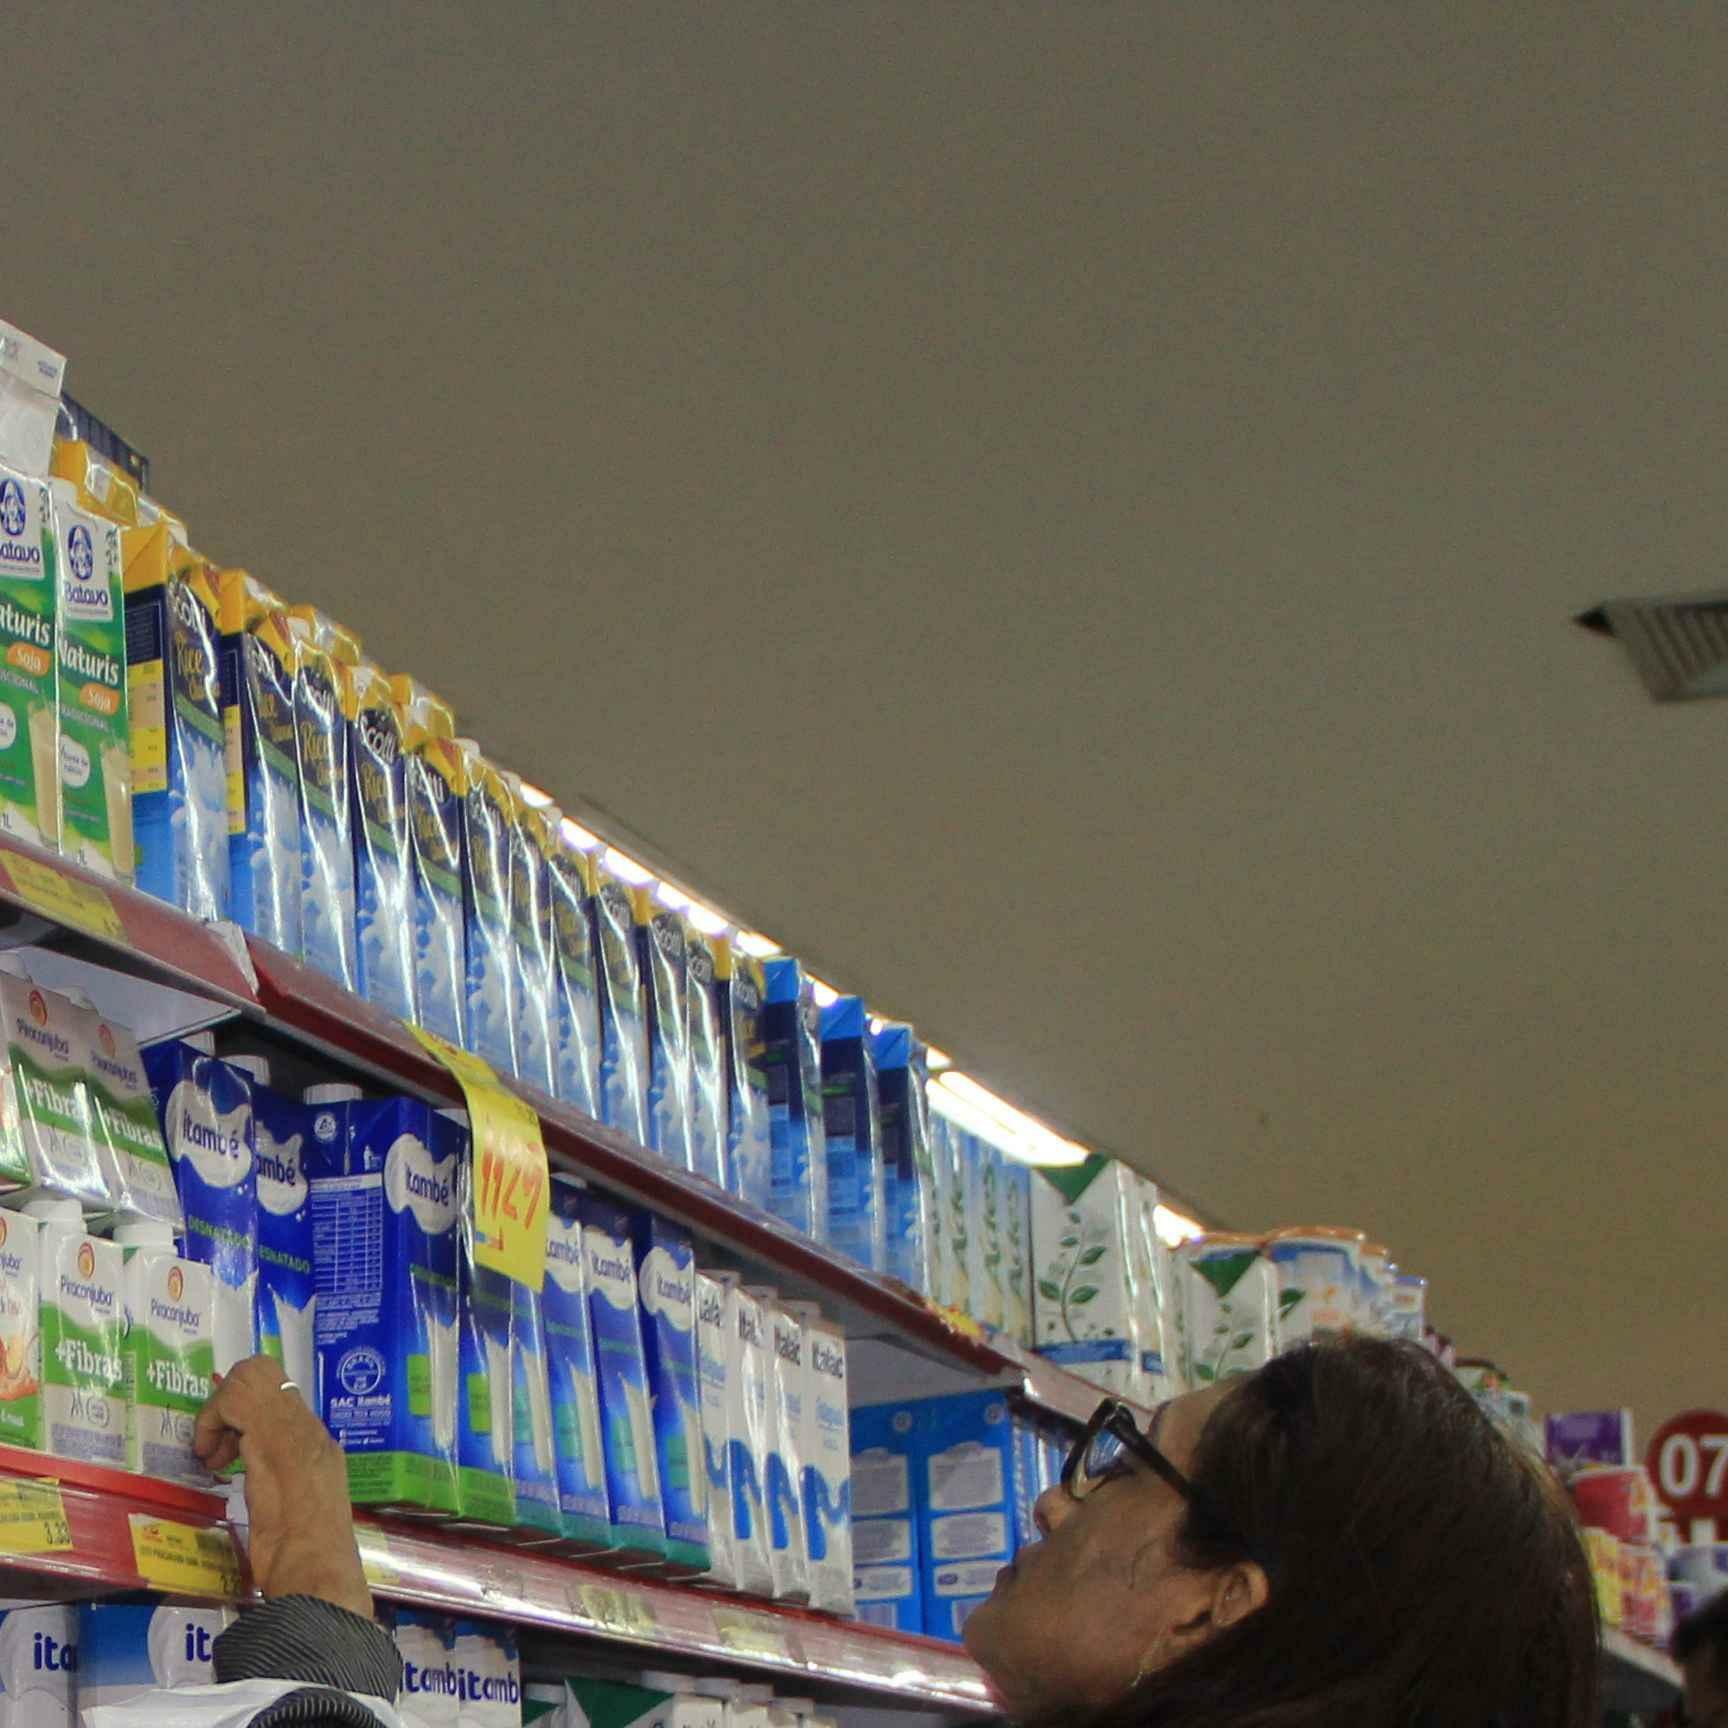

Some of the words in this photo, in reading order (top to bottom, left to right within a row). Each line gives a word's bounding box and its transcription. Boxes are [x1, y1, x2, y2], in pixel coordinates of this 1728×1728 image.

[13, 648, 44, 674] Soja
[86, 690, 115, 712] Soja
[146, 1360, 210, 1397] +Fibras
[1659, 1432, 1728, 1499] 07
[42, 1519, 71, 1546] 3.33
